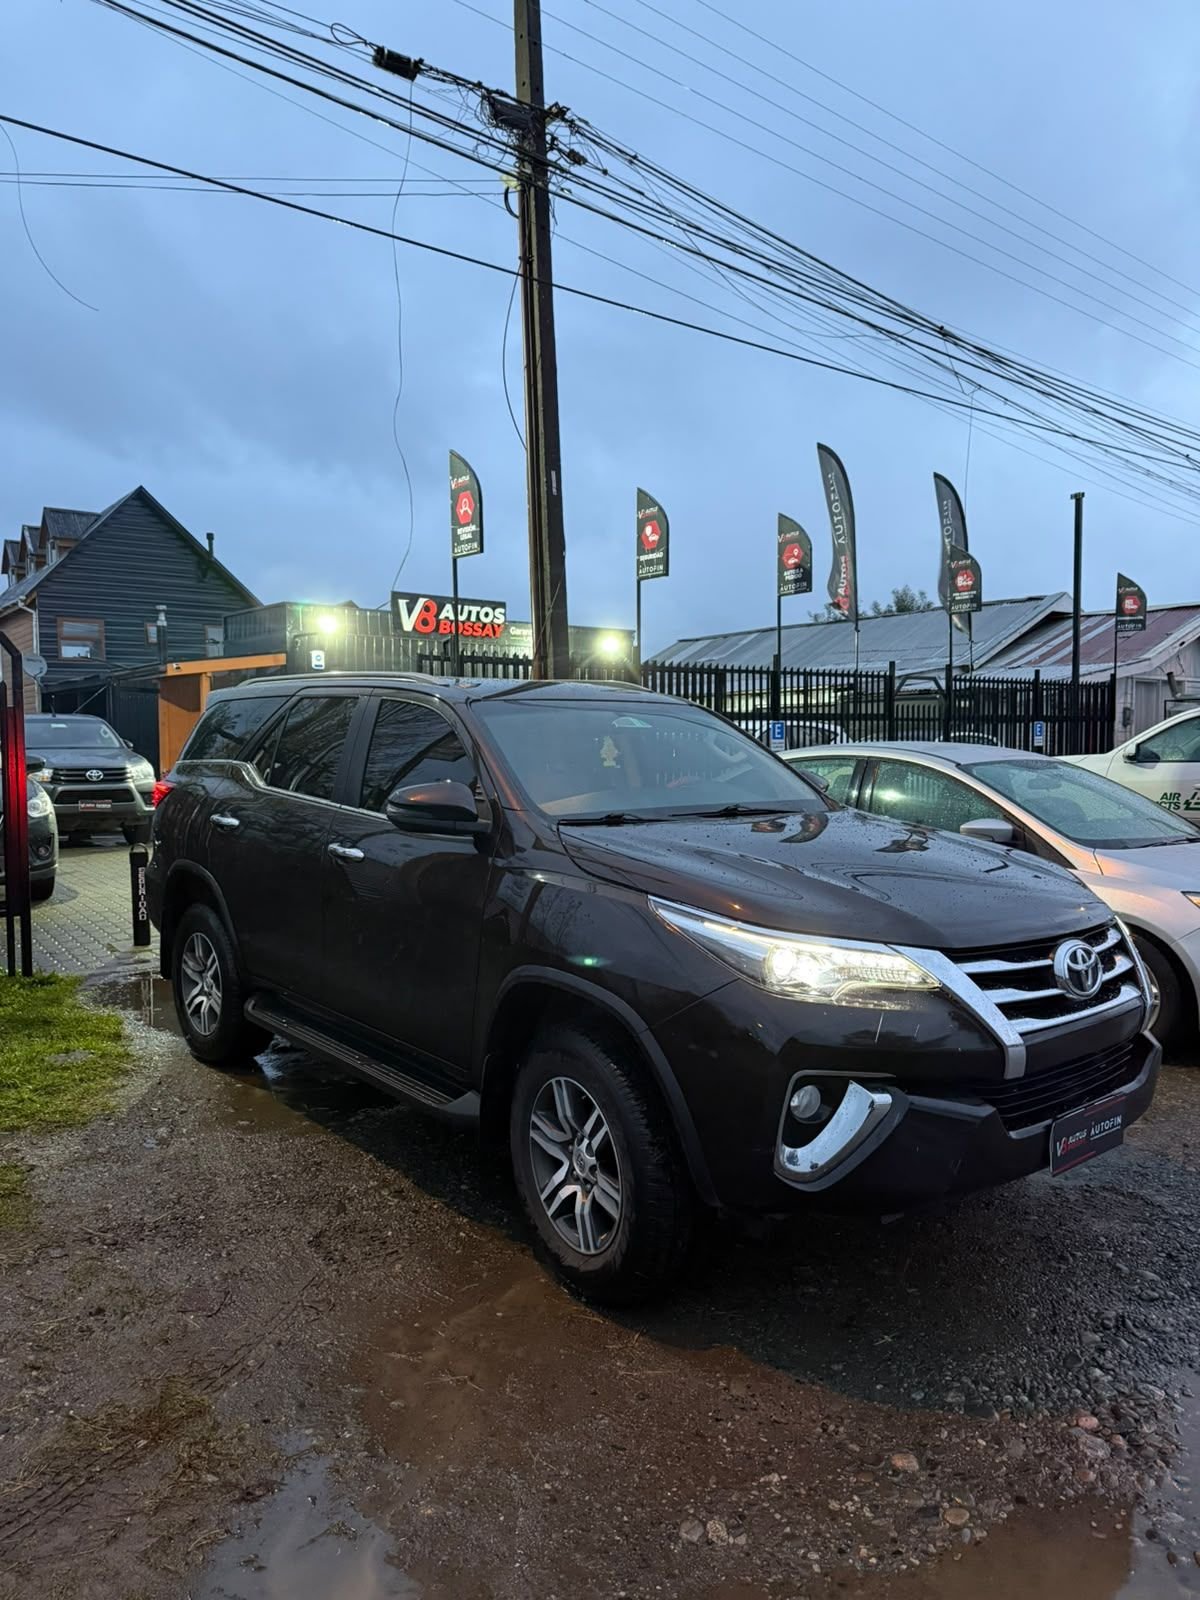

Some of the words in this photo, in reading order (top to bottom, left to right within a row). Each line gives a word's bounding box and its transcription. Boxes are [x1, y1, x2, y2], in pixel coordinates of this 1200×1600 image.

[454, 542, 478, 553] AUTOFIN
[639, 564, 664, 574] AUTOFIN
[398, 597, 438, 634] V8
[438, 603, 505, 624] AUTOS
[438, 620, 504, 638] BOSSAY
[775, 724, 782, 738] E
[1160, 792, 1181, 801] AIR
[1156, 801, 1181, 810] CTS
[1090, 1115, 1122, 1137] AUTOFIN
